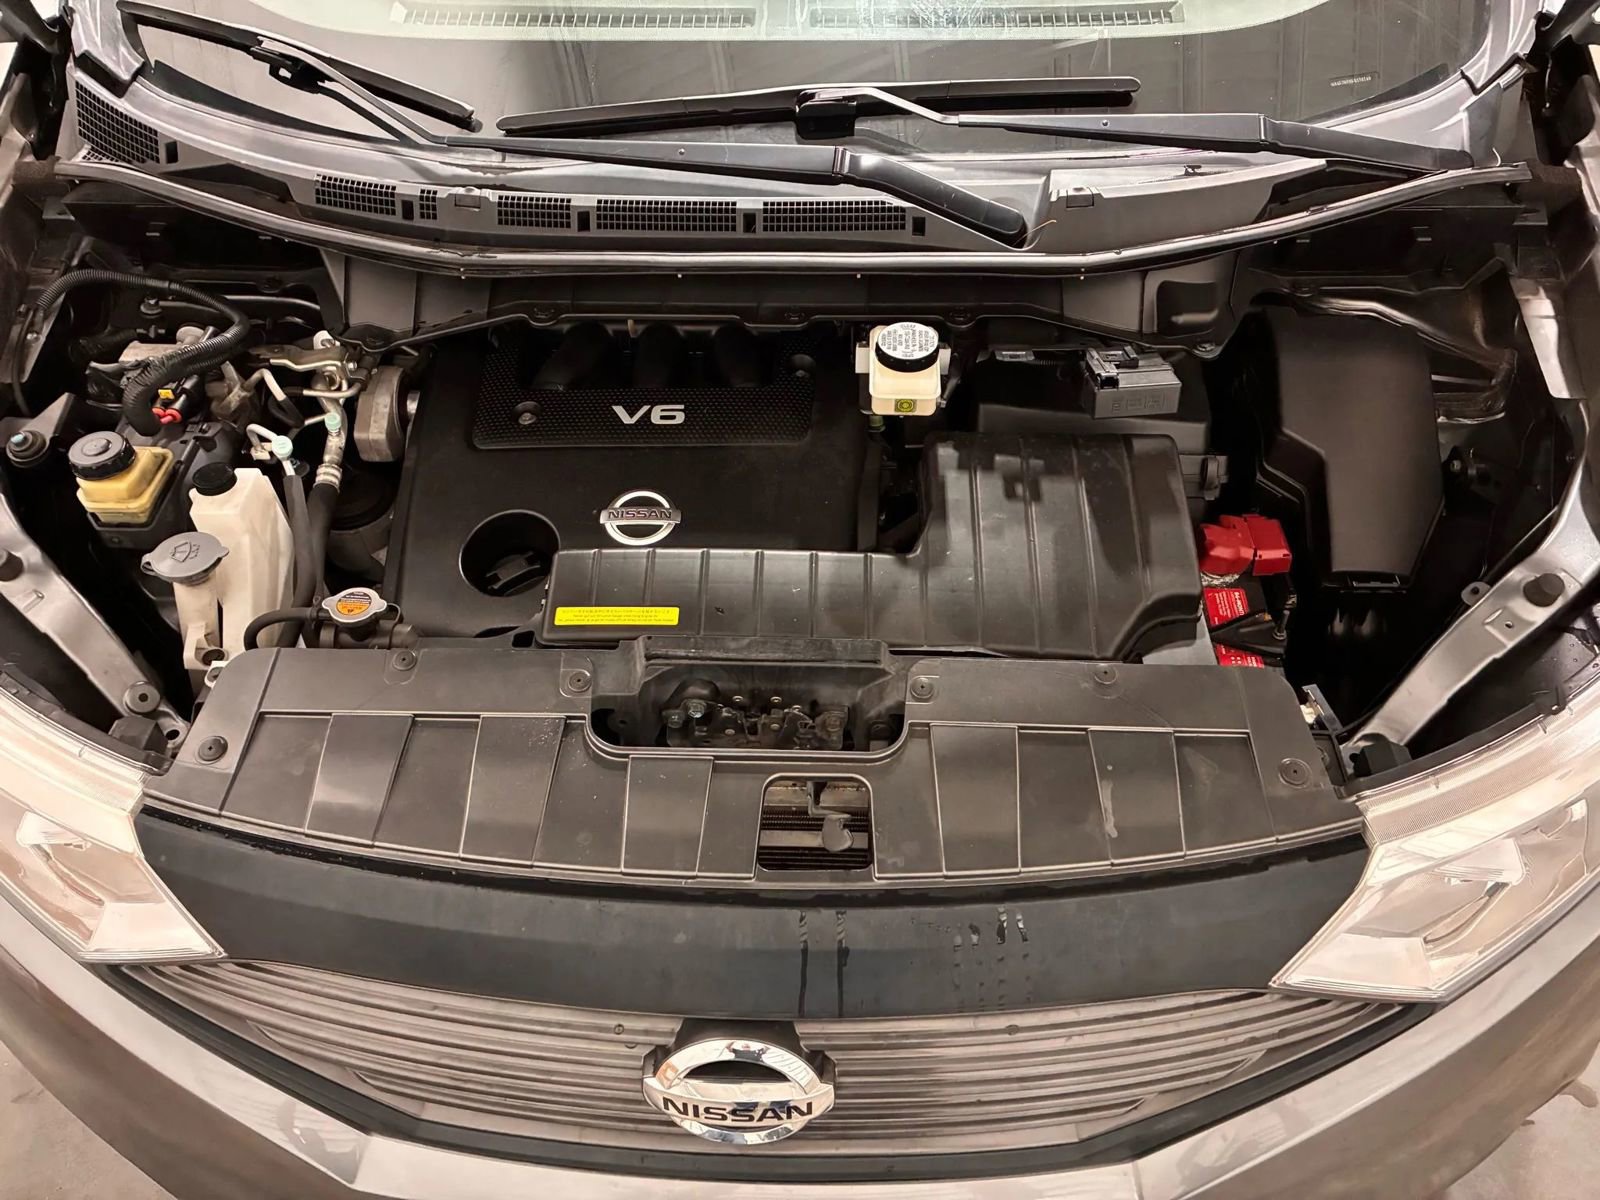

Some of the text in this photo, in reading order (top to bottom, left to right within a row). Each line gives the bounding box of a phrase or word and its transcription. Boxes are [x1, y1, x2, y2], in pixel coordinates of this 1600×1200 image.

[611, 404, 685, 425] V6
[608, 508, 673, 520] NISSAN
[662, 1097, 813, 1122] NISSAN
